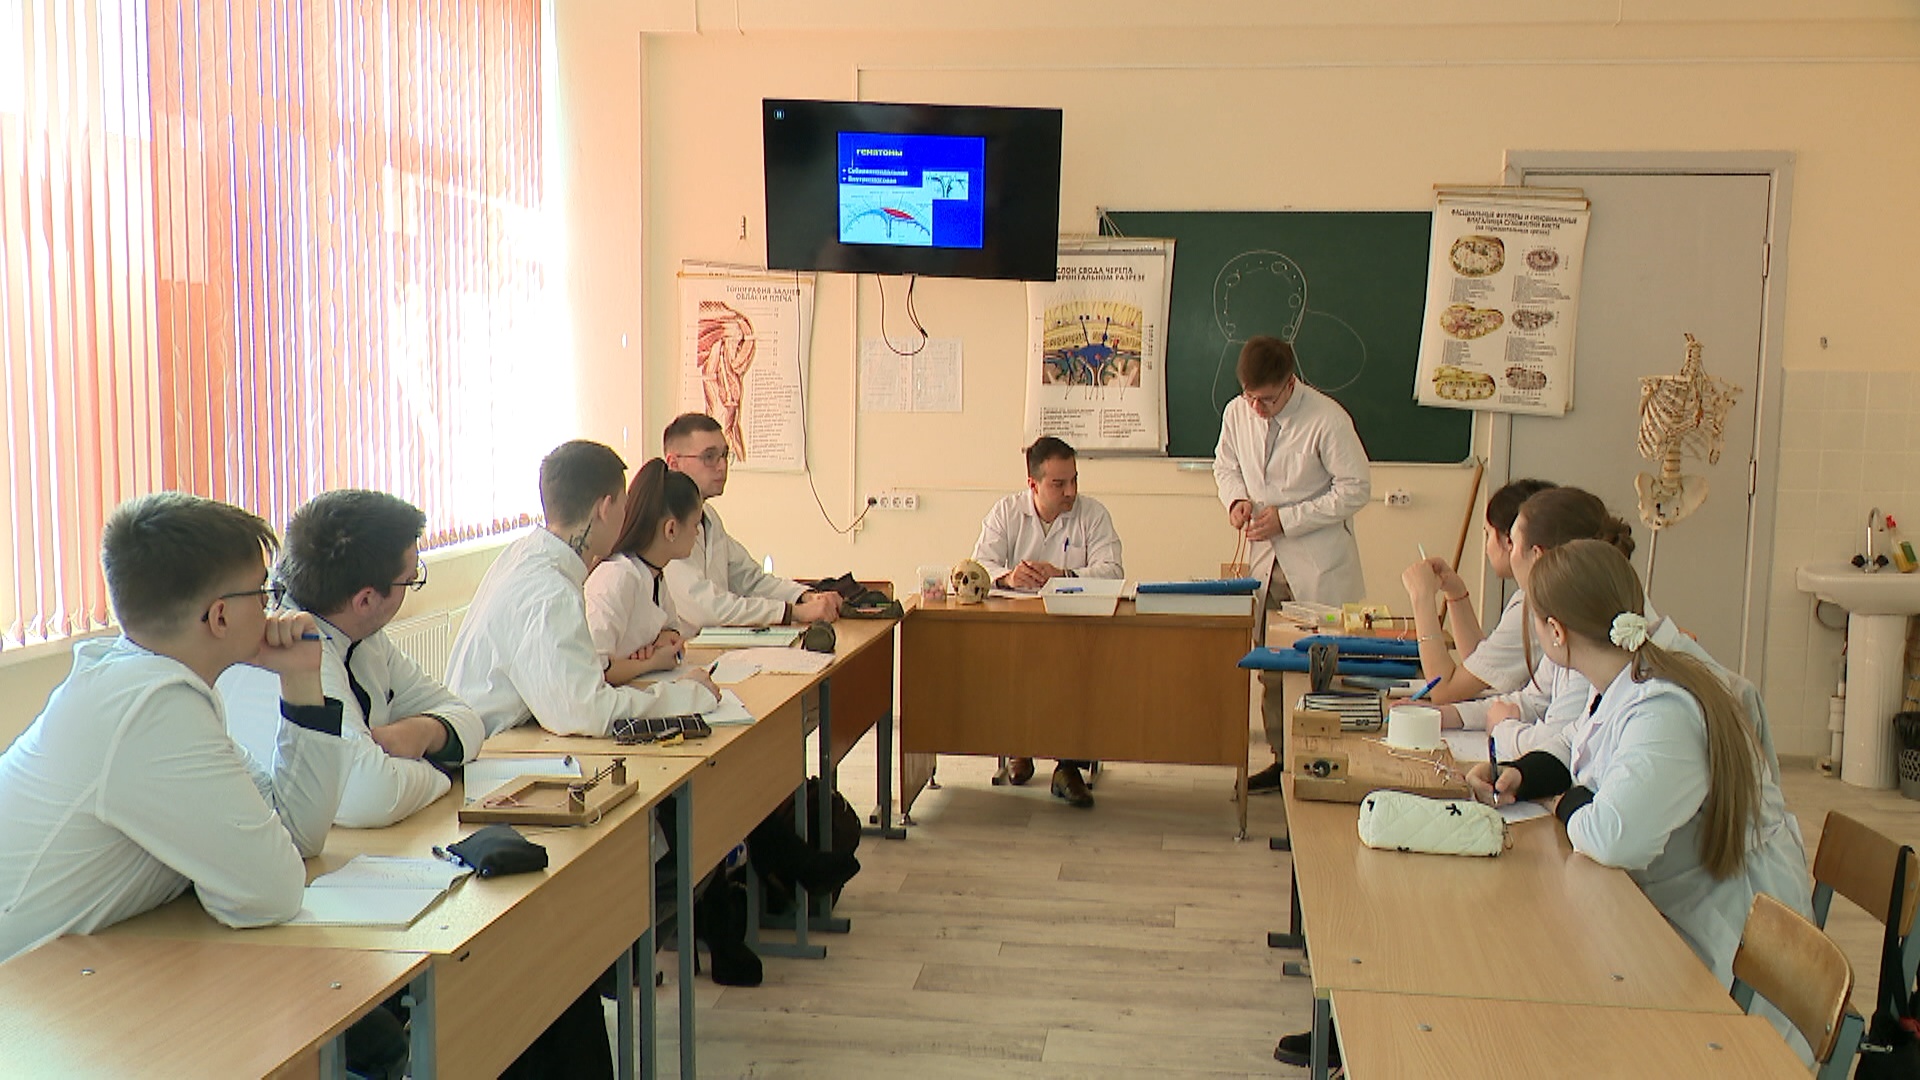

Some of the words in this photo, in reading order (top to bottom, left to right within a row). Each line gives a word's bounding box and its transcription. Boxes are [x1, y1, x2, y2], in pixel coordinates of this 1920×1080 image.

[1451, 209, 1494, 218] ФАСЦИАЛЬНЫЕ
[726, 285, 771, 294] ТОПОГРАФИЯ
[736, 293, 767, 301] ОБЛАСТИ
[769, 294, 792, 302] ПЛЕЧА
